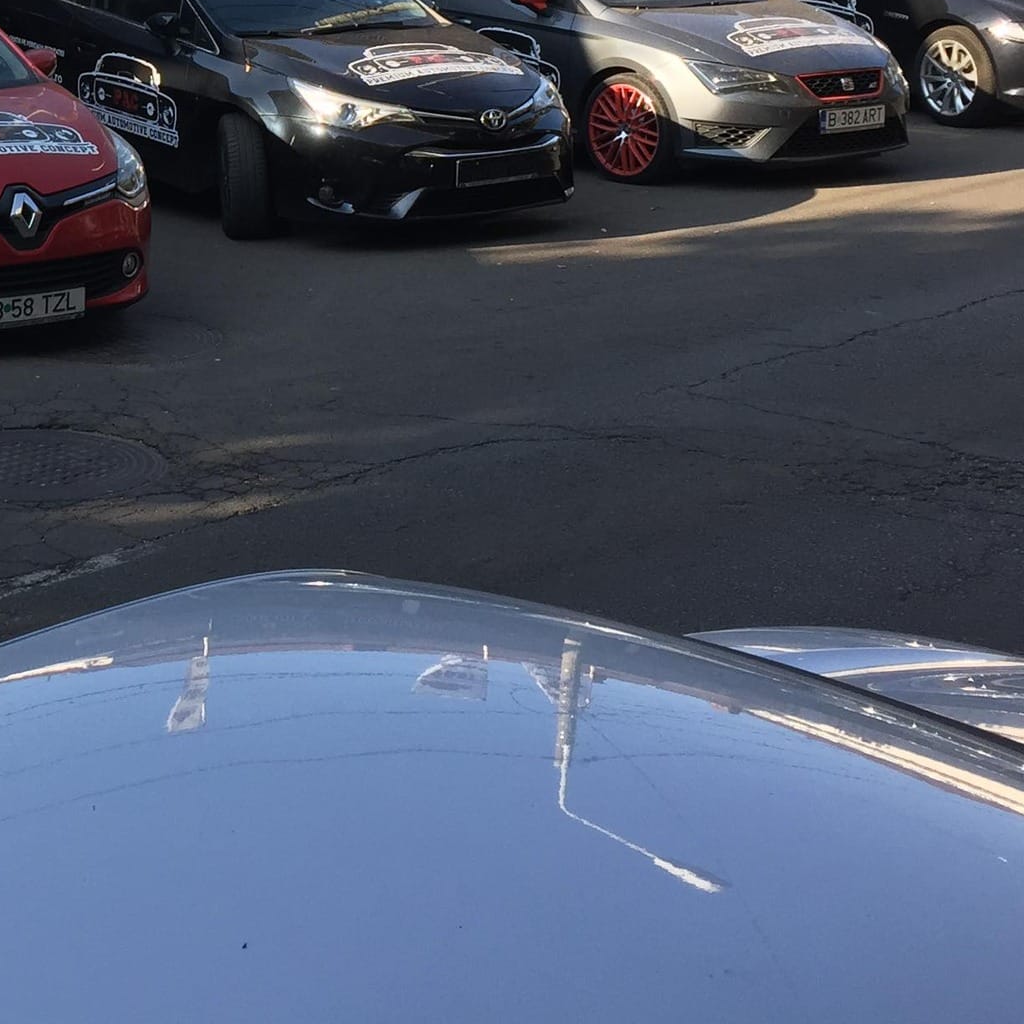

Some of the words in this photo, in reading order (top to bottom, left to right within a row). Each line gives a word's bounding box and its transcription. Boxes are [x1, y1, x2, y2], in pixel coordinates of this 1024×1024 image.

[829, 113, 837, 127] B
[841, 110, 860, 125] 382
[863, 107, 883, 123] ART
[40, 144, 97, 155] CONCEPT
[11, 297, 34, 318] 58
[42, 291, 76, 314] TZL
